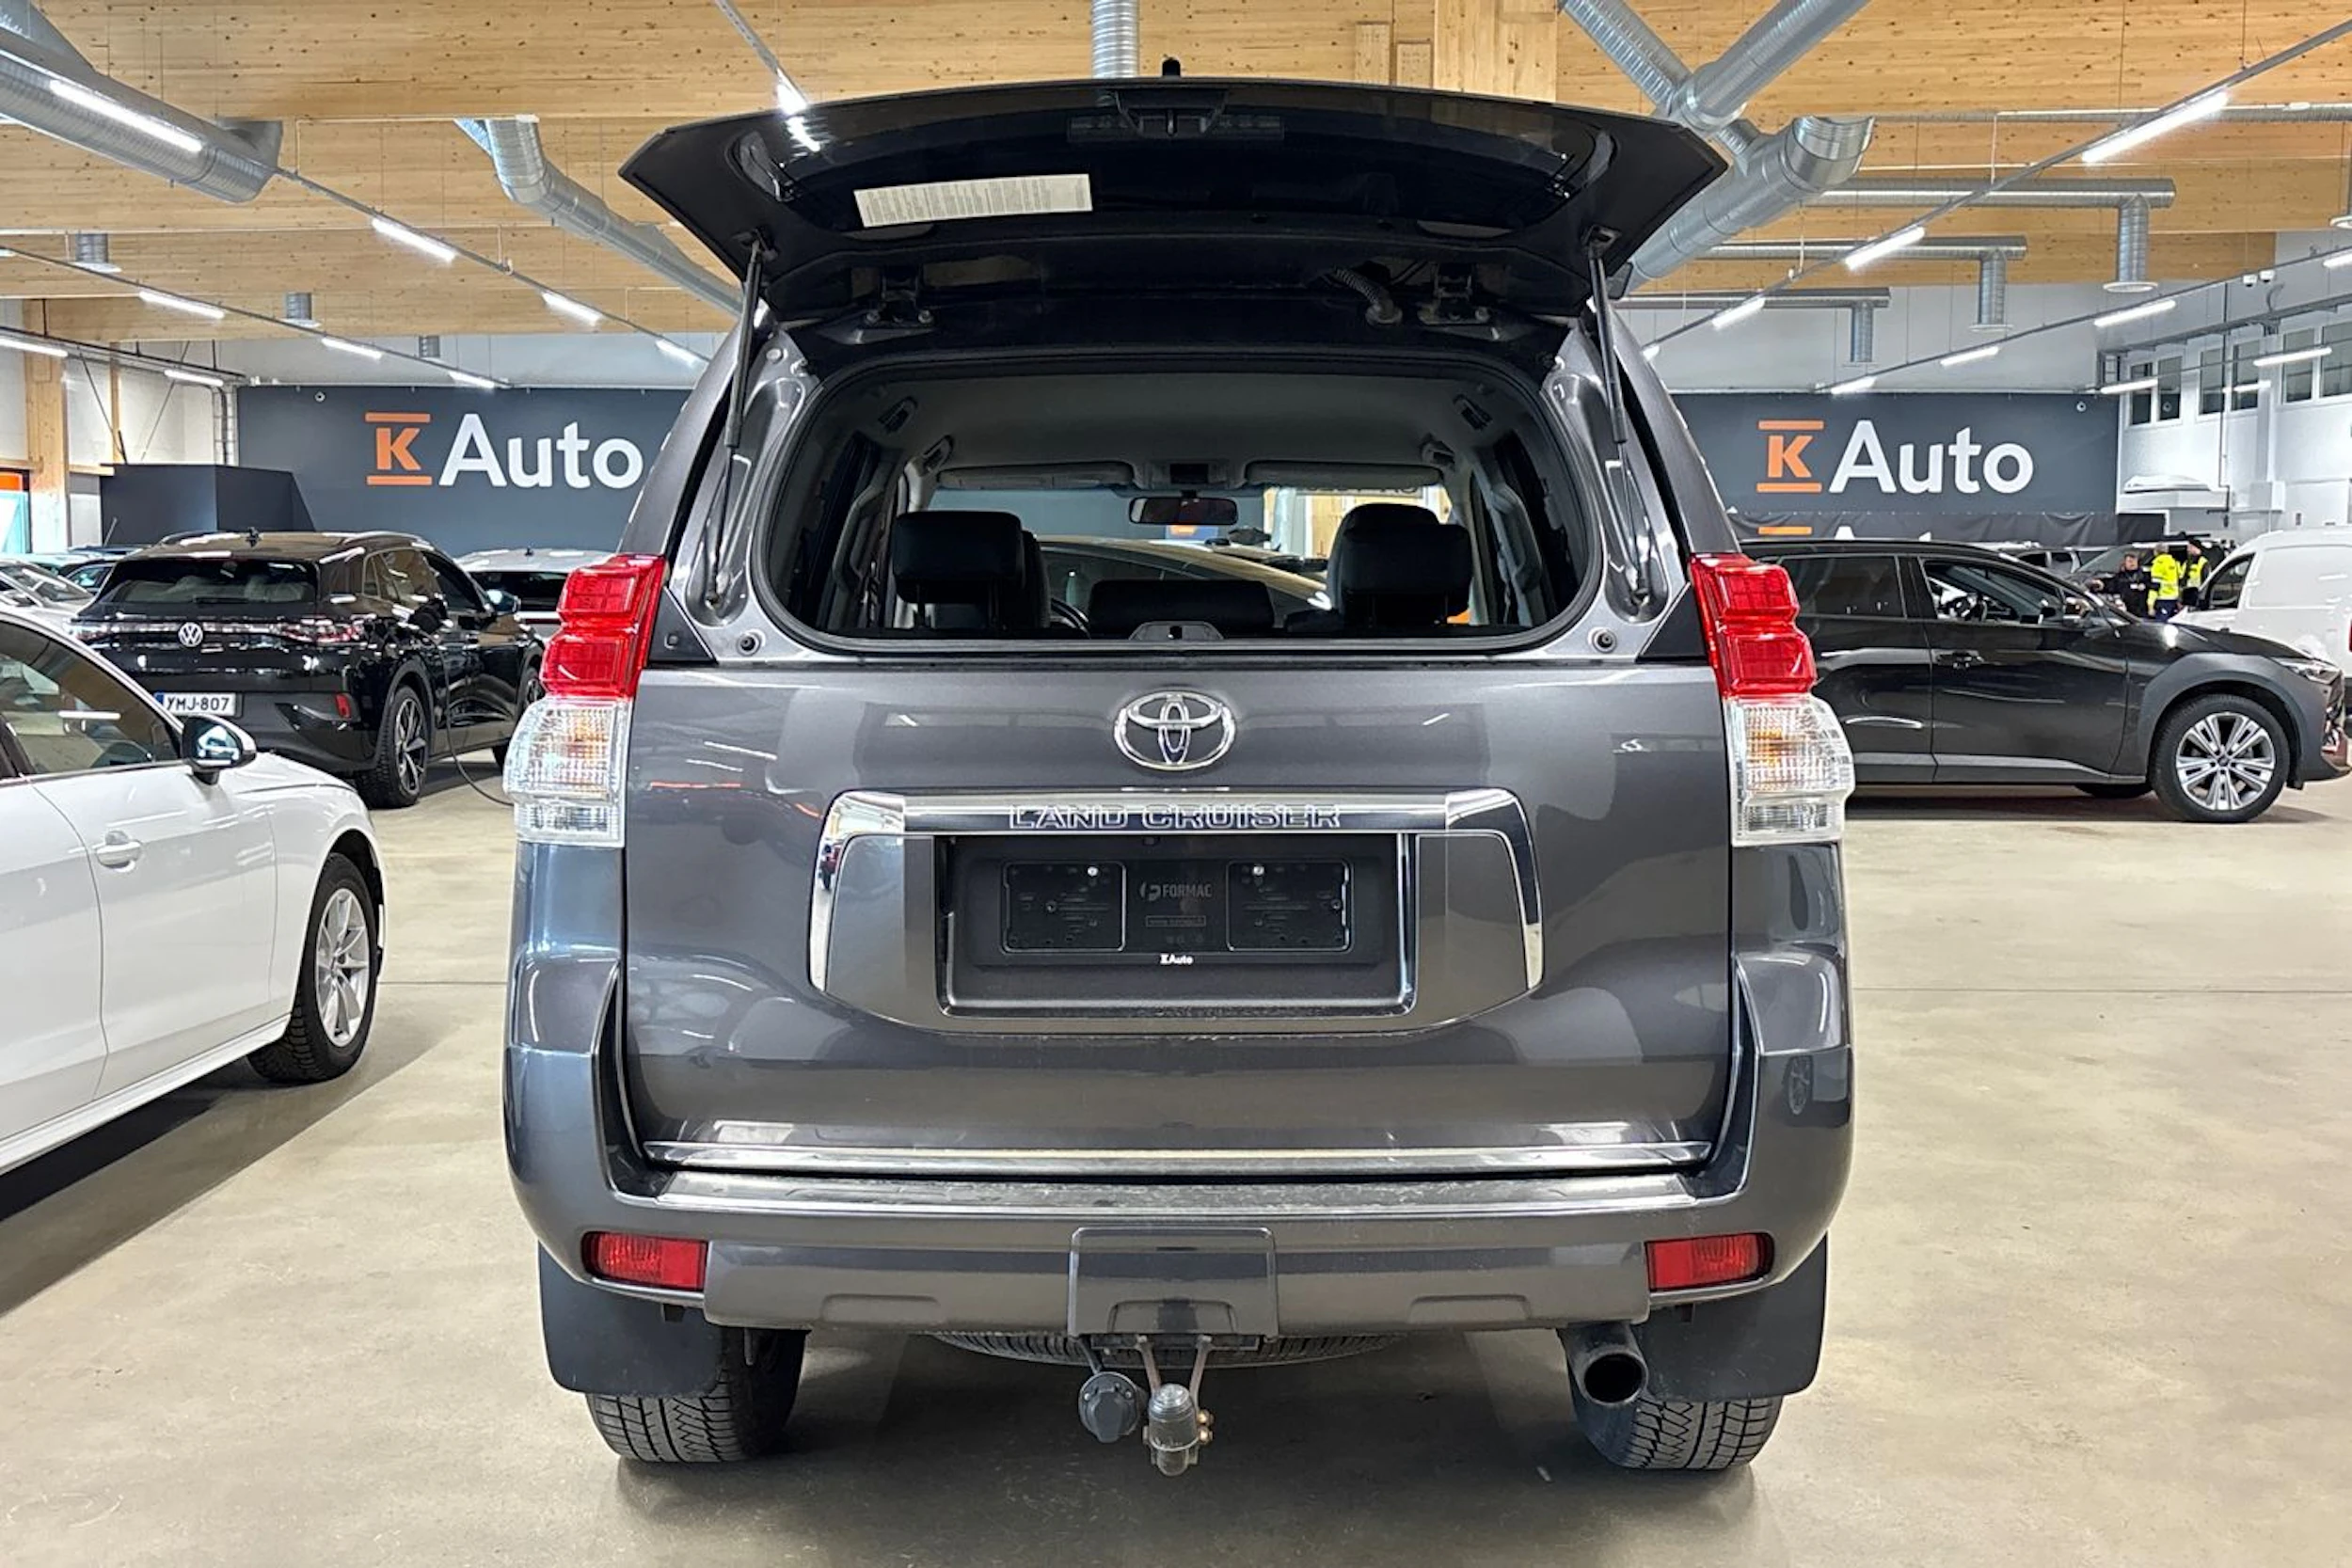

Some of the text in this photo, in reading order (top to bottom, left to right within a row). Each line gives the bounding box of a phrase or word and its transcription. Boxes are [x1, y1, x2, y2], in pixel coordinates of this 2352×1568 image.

[376, 413, 644, 489] K Auto
[1767, 420, 2034, 494] K Auto
[1009, 804, 1341, 830] LAND CRUISER
[1162, 883, 1213, 898] FORMAC
